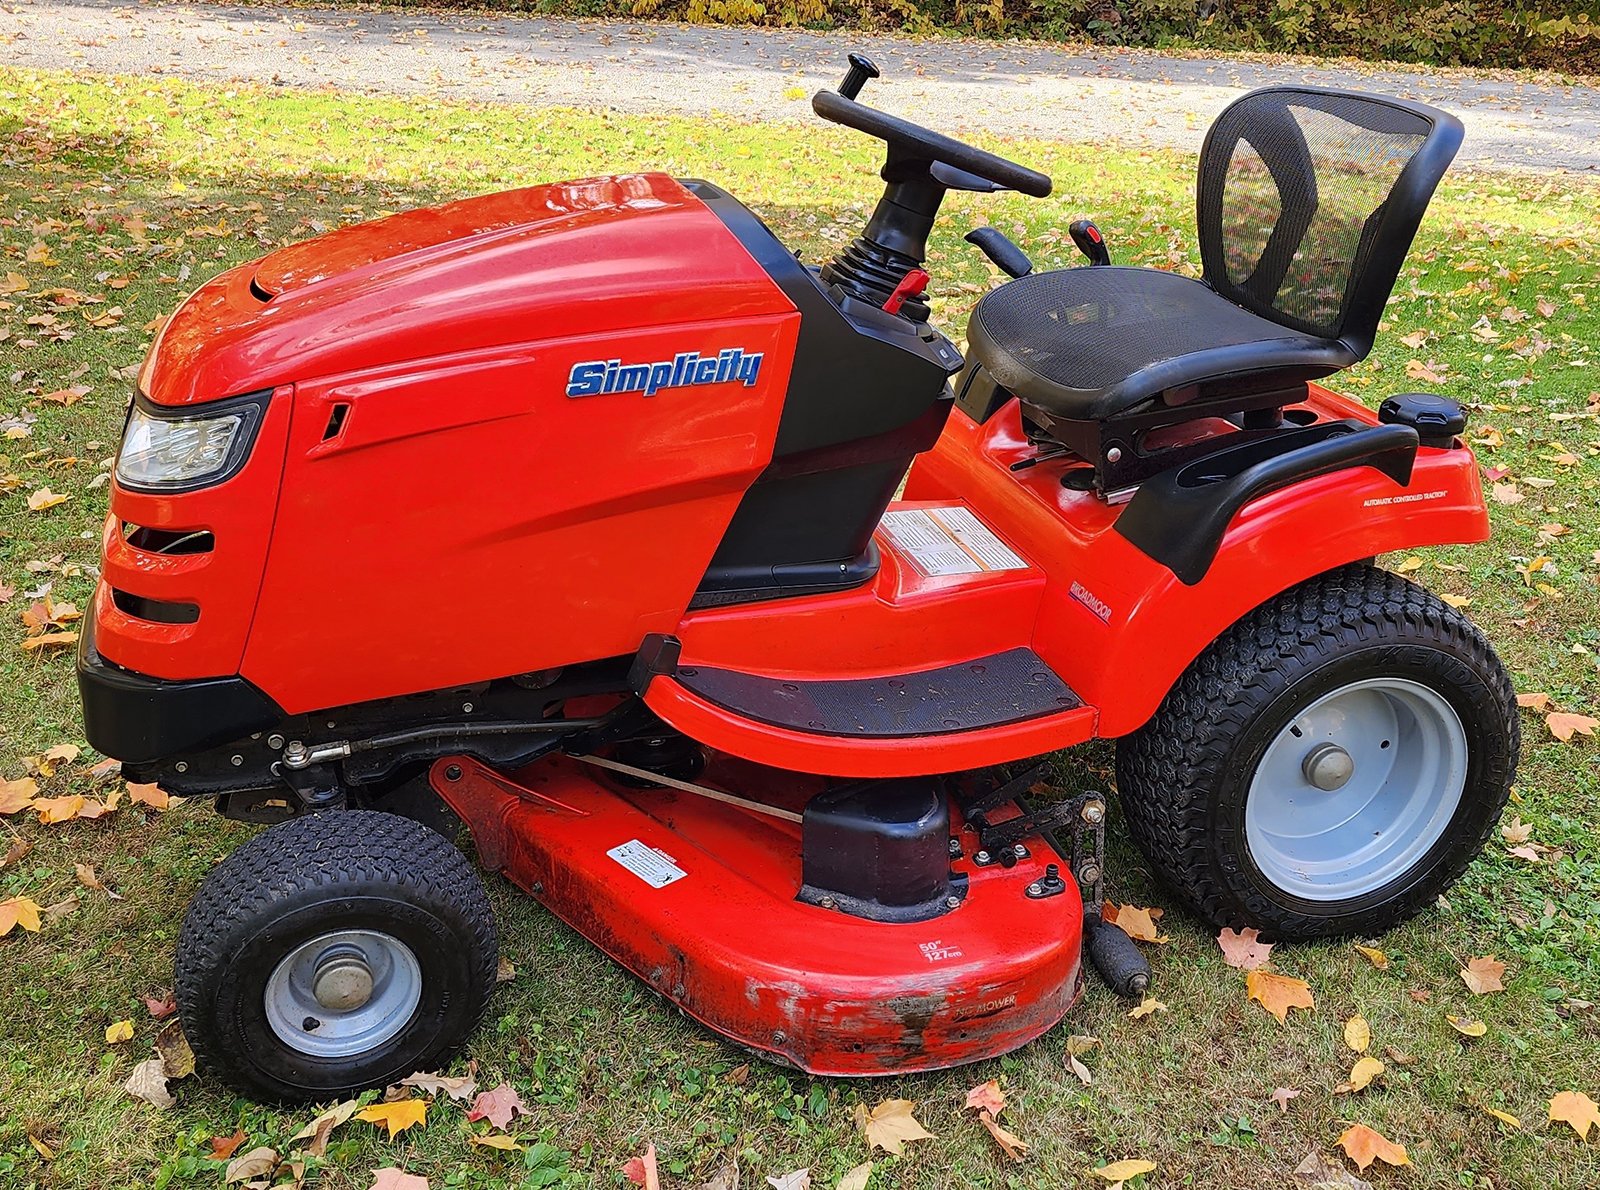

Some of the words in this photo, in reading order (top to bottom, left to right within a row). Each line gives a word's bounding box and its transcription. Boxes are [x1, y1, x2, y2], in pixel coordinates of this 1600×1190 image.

[565, 347, 764, 397] Simplicity
[1070, 580, 1112, 621] BROADMOOR
[919, 940, 942, 952] 50"
[924, 950, 963, 962] 127cm
[976, 995, 1015, 1014] MOWER
